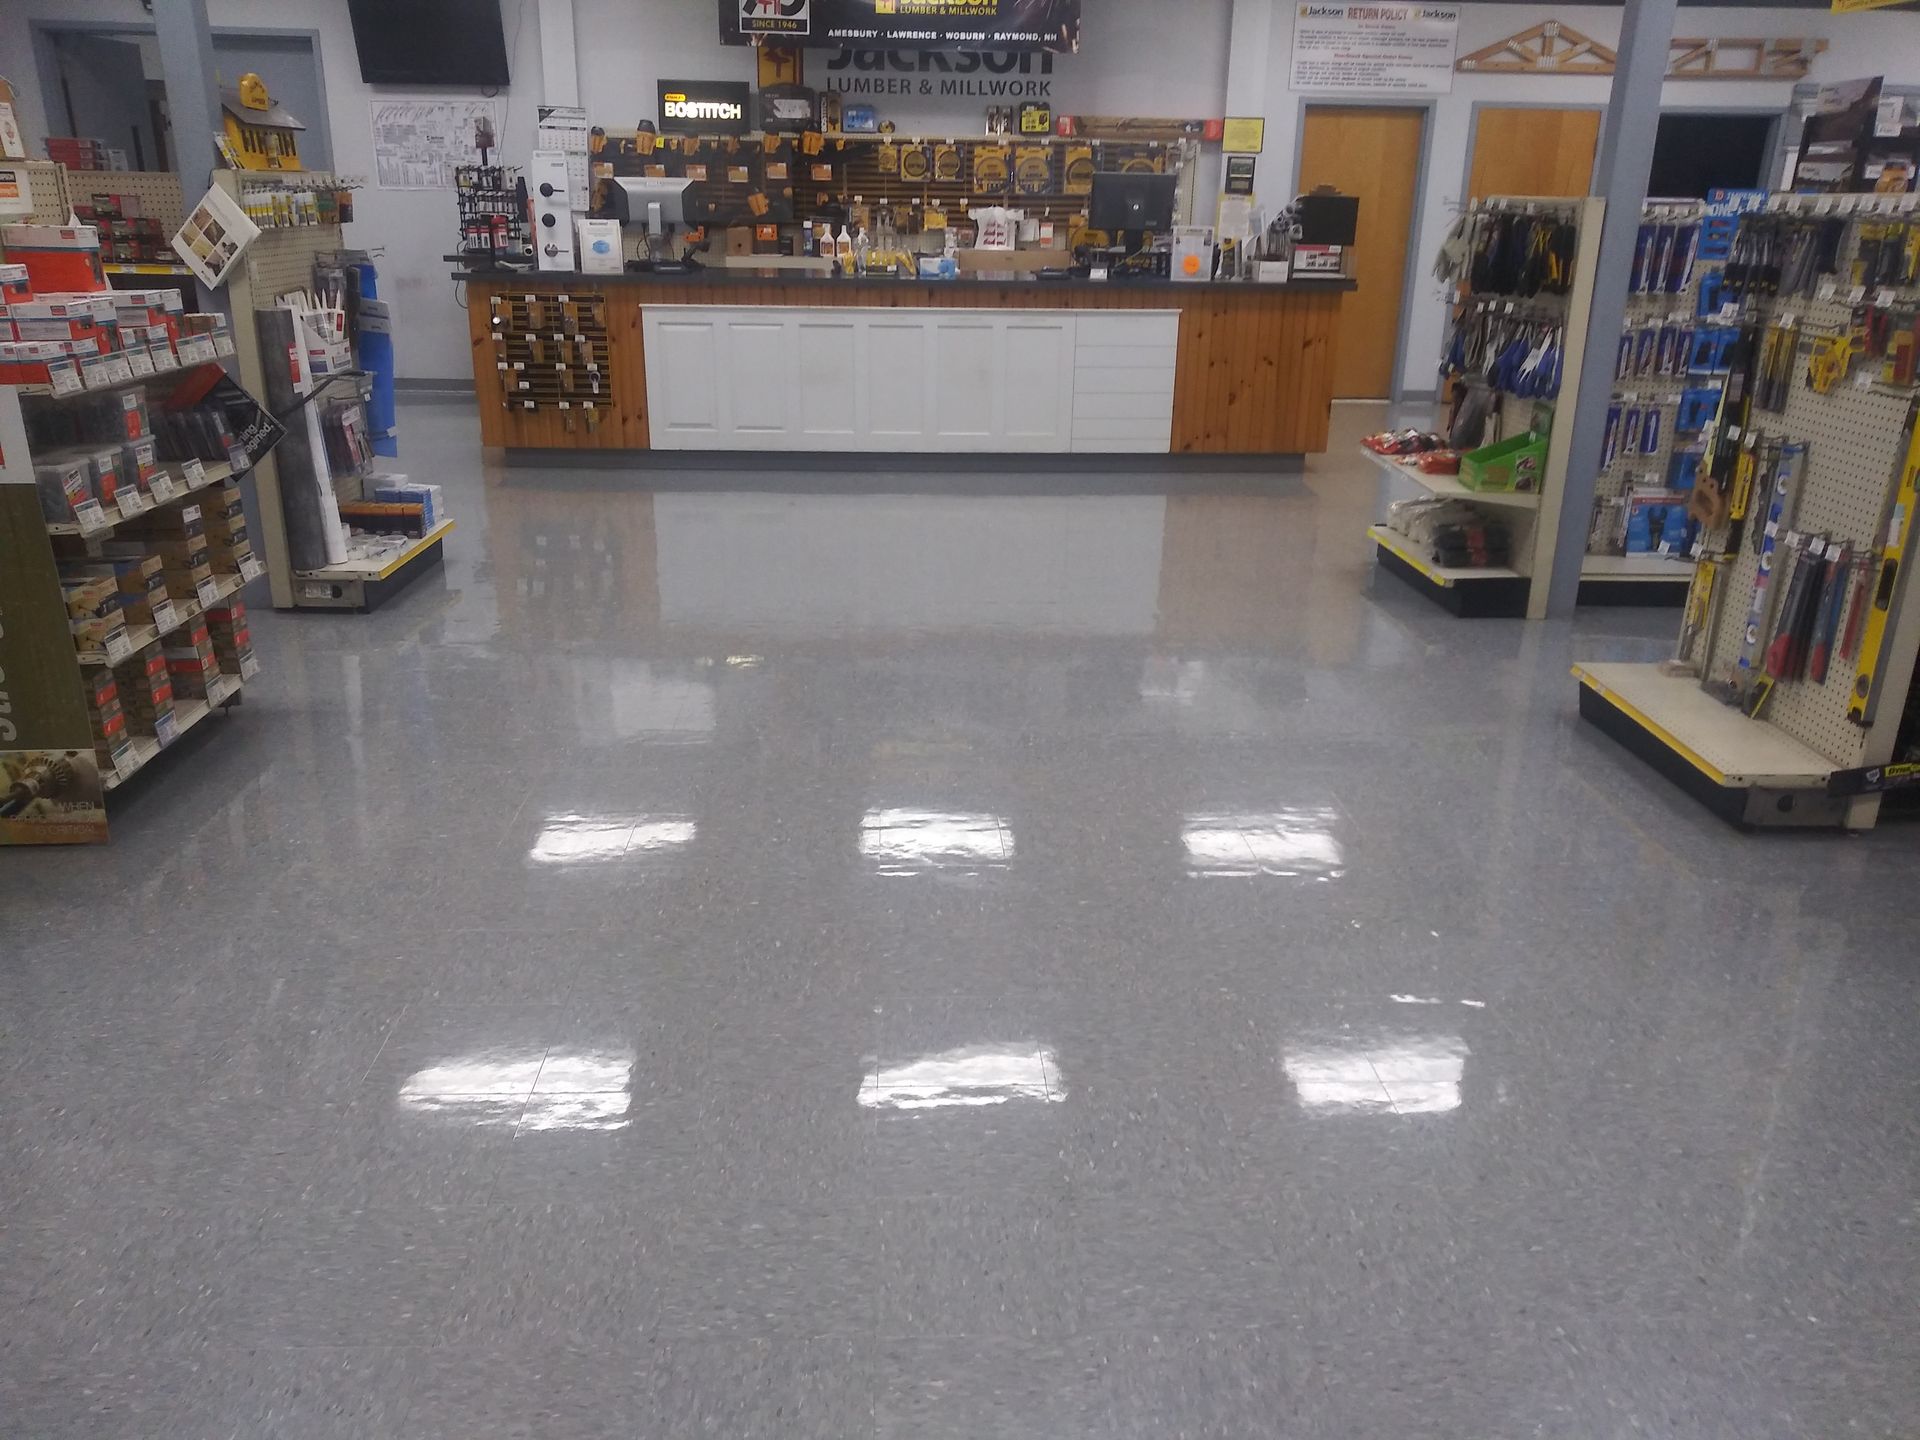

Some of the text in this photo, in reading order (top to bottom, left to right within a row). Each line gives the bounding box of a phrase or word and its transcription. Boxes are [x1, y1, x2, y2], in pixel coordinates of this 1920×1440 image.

[900, 6, 997, 16] LUMBER & MILLWORK
[1309, 6, 1344, 17] Jackson
[1347, 7, 1409, 21] RETURN POLICY
[1422, 9, 1457, 20] Jackson
[752, 20, 798, 30] SINCE 1946
[827, 29, 1058, 43] AMESBURY LAWRENCE WOBURN RAYMOND, NH
[826, 77, 1051, 97] LUMBER & MILLWORK
[664, 102, 742, 119] BOSTITCH
